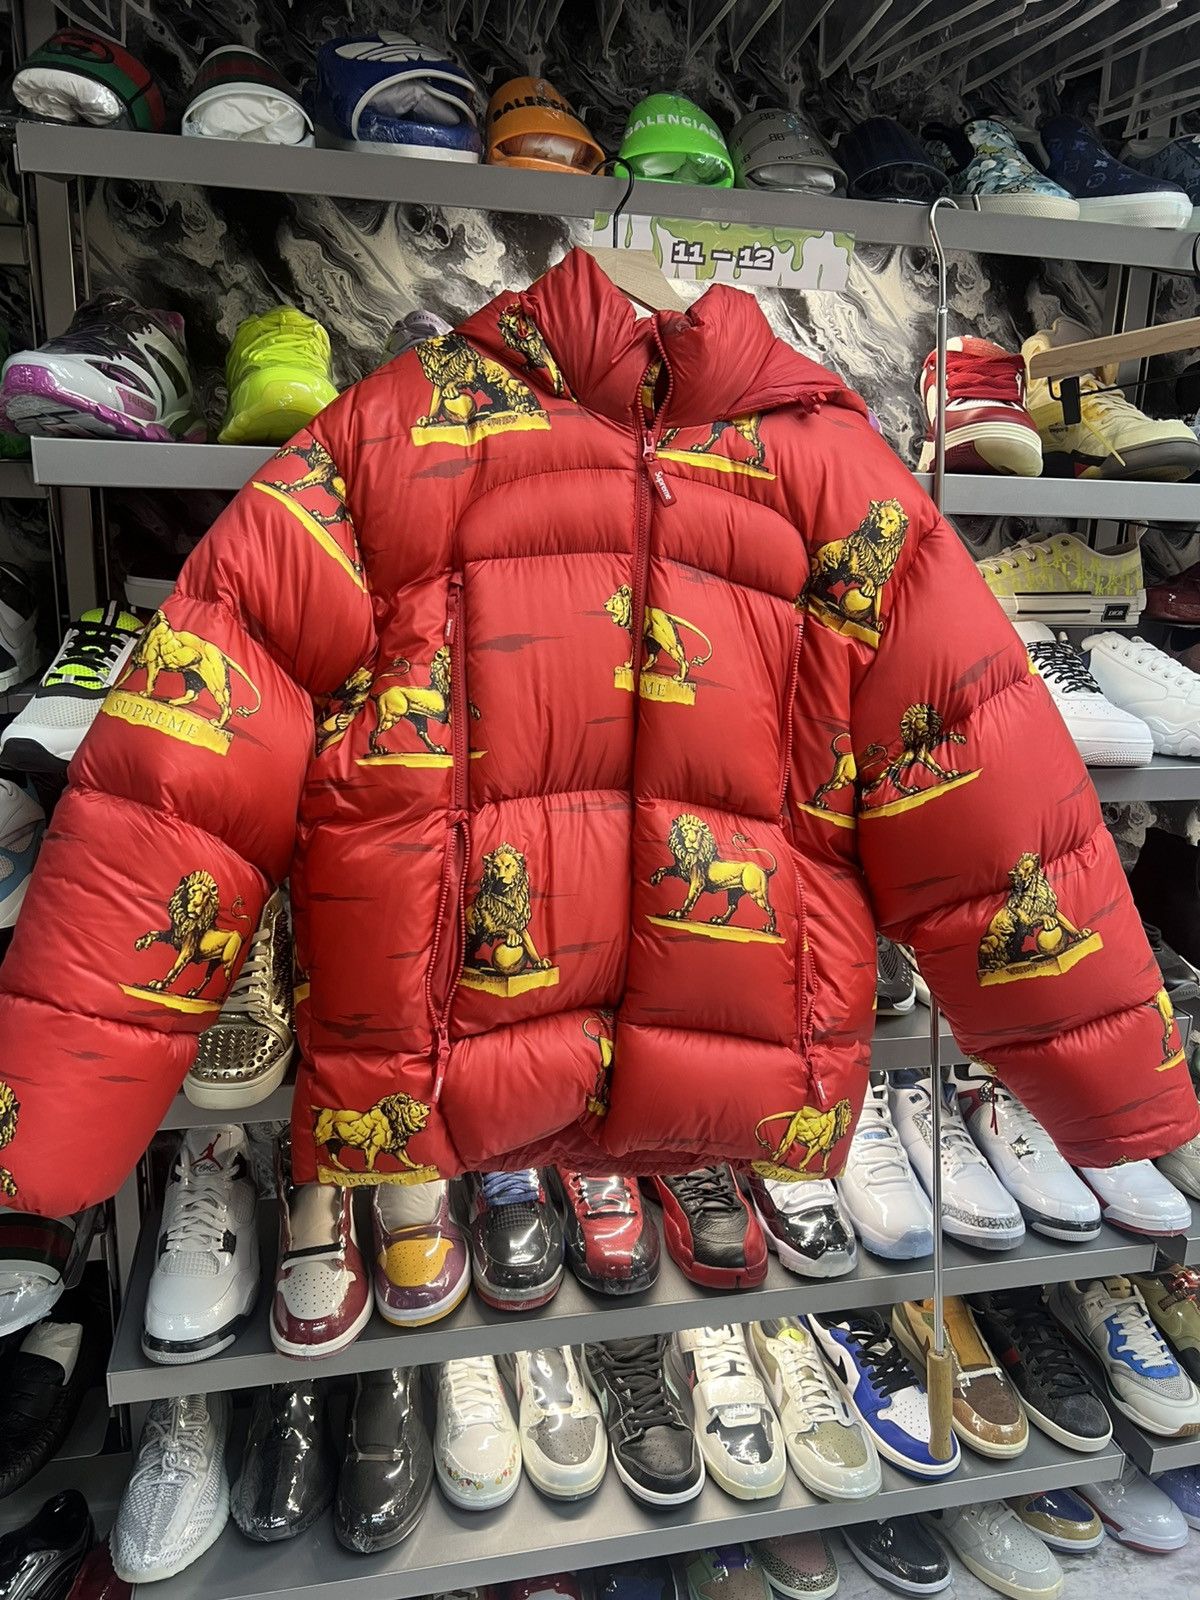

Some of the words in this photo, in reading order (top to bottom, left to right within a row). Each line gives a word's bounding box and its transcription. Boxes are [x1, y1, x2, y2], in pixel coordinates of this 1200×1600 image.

[671, 240, 706, 265] 11
[736, 244, 774, 271] 12
[654, 470, 672, 500] Supreme
[111, 699, 200, 739] SUPREME
